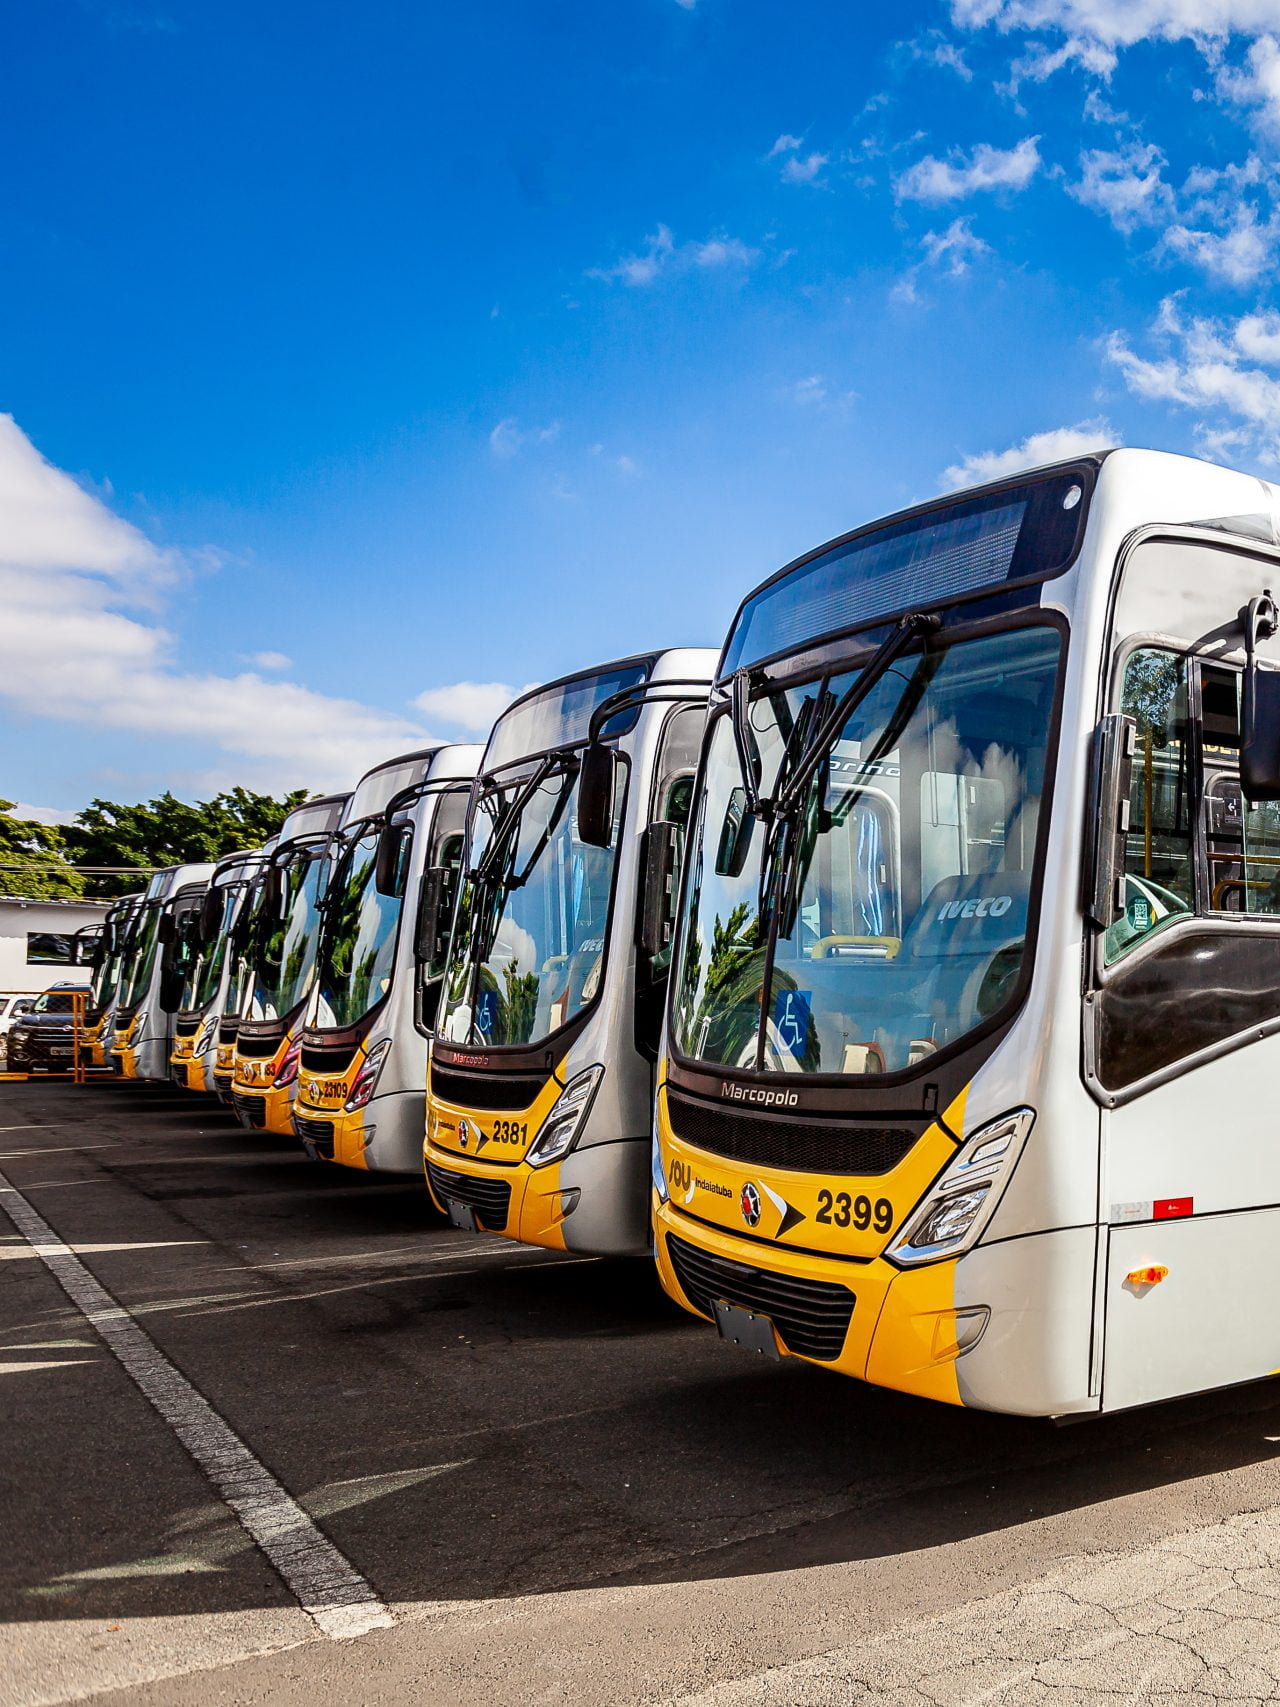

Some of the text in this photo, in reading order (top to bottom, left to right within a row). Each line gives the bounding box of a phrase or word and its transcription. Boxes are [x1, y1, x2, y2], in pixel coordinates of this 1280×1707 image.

[938, 896, 1012, 921] IVECO
[453, 1052, 489, 1065] Marcopolo
[324, 1082, 348, 1099] 23109
[721, 1082, 799, 1106] Marcopolo
[493, 1120, 528, 1146] 2381
[695, 1176, 733, 1199] Indaiatuba
[816, 1189, 894, 1235] 2399
